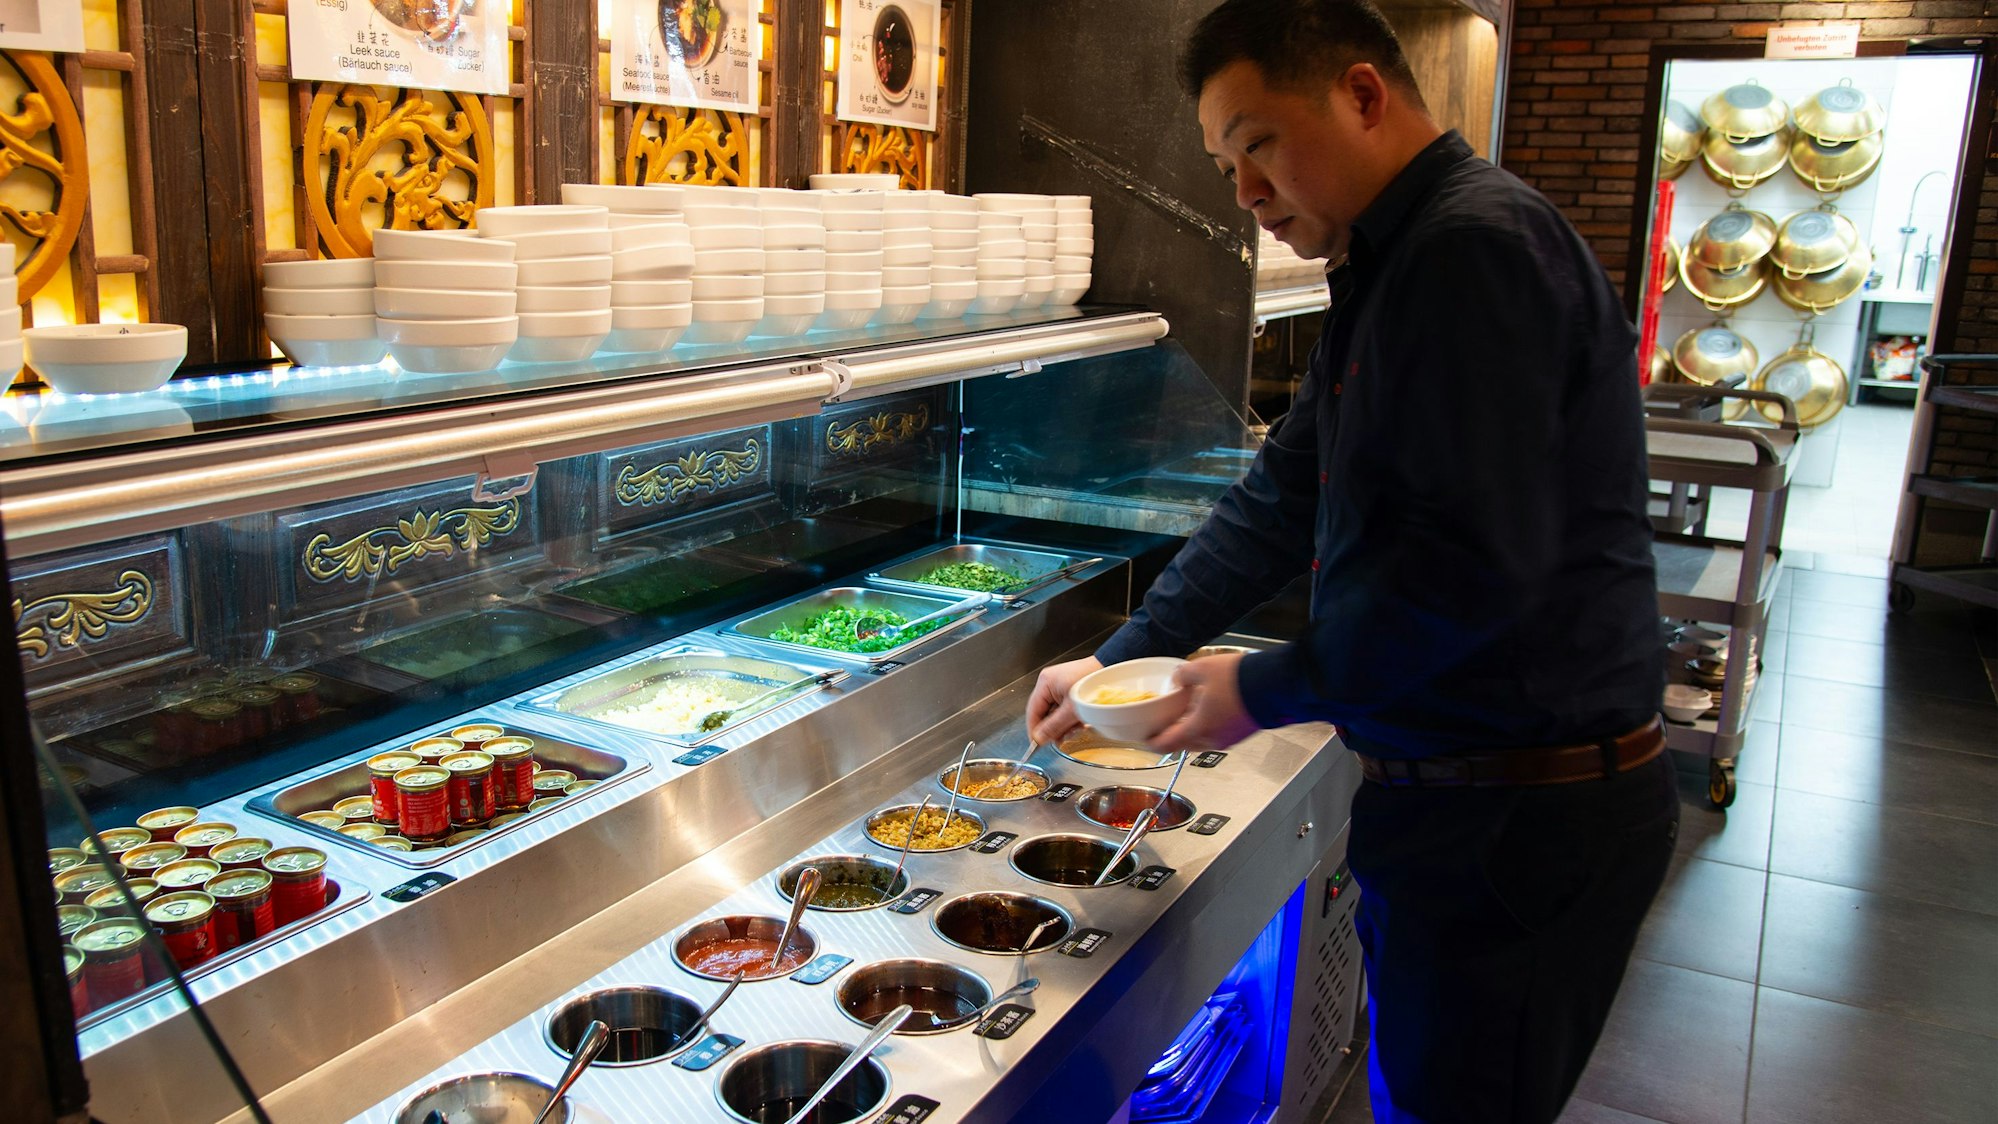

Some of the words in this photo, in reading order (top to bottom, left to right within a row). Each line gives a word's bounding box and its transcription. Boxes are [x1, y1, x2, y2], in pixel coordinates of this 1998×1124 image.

[1777, 35, 1821, 43] Unbefugten
[1823, 34, 1847, 42] Zutritt
[350, 44, 372, 56] Leek
[374, 48, 400, 59] sauce
[458, 46, 480, 60] Sugar
[338, 56, 381, 71] (Bärlauch
[384, 61, 412, 75] sauce)
[653, 73, 669, 81] sauce
[704, 69, 720, 85] 香油
[711, 87, 732, 98] Sesame
